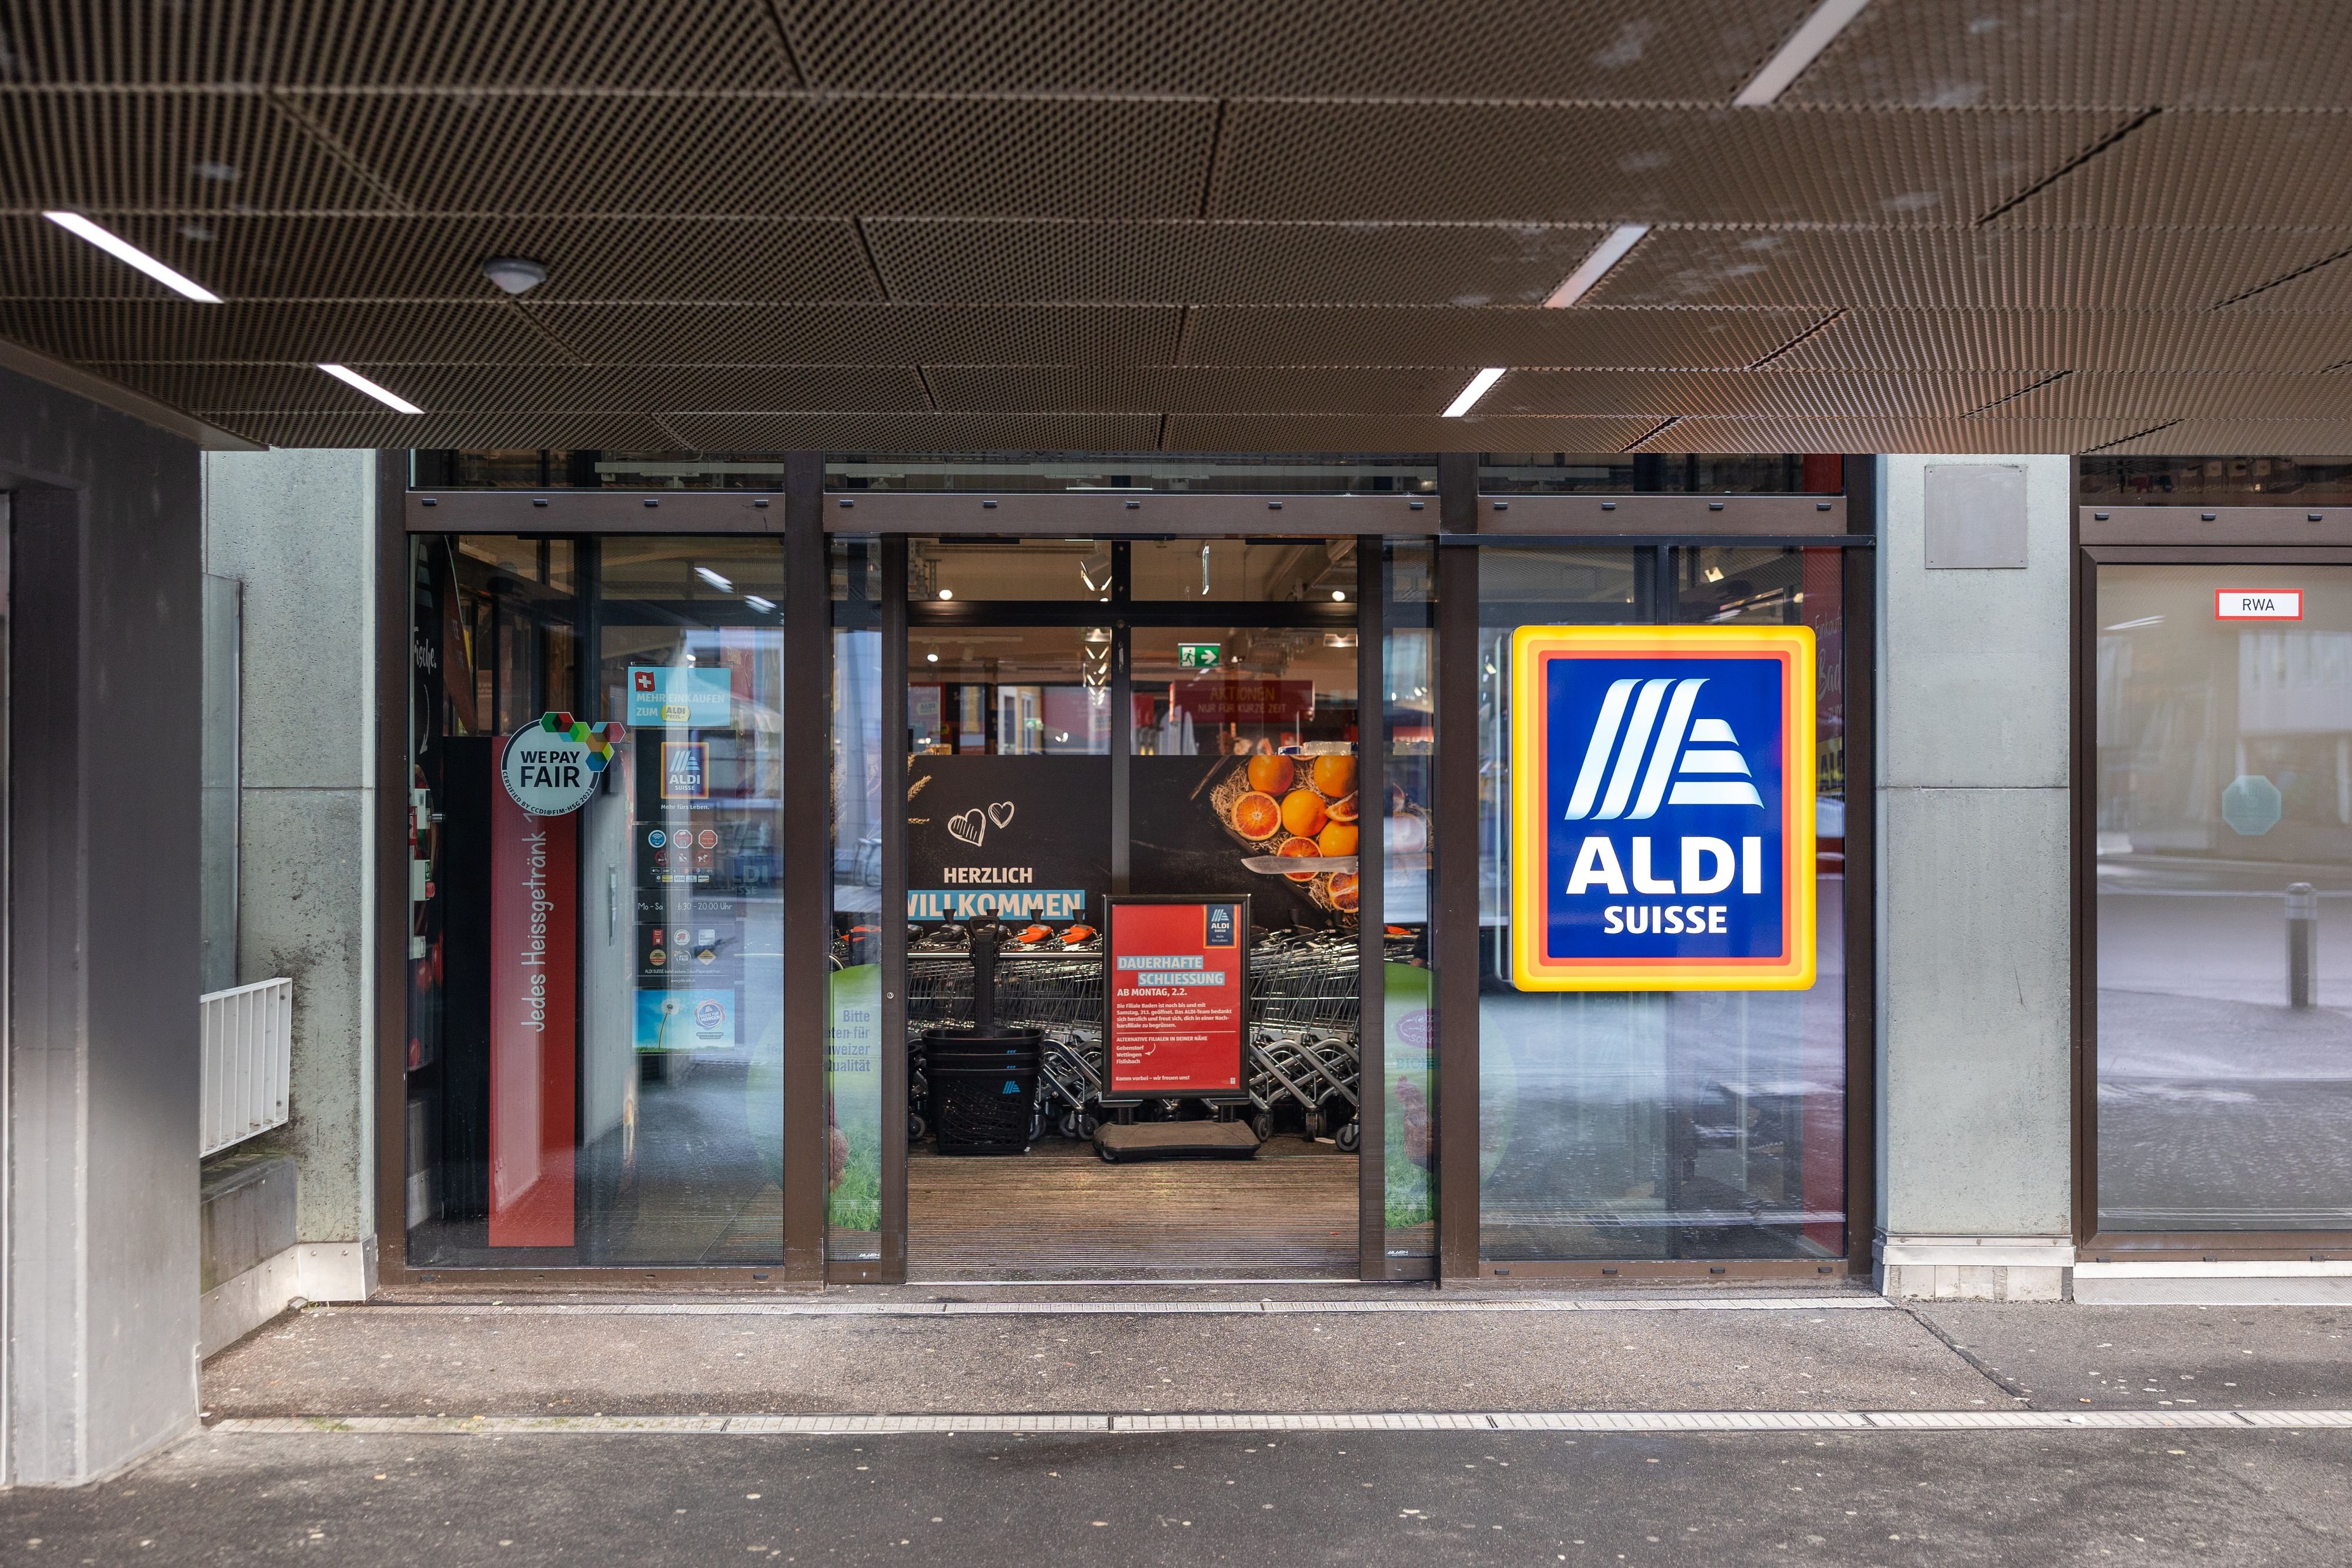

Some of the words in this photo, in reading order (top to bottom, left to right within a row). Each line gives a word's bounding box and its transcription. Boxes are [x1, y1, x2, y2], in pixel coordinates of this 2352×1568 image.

[2243, 599, 2274, 611] RWA
[636, 693, 666, 702] MEHR
[667, 694, 724, 703] EINKAUFEN
[1210, 687, 1275, 701] AKTIONEN
[636, 707, 658, 717] ZUM
[1198, 703, 1215, 713] NUR
[1238, 703, 1264, 713] KURZE
[1268, 703, 1287, 713] ZEIT
[520, 751, 547, 763] WE
[550, 751, 580, 763] PAY
[520, 766, 580, 787] FAIR
[669, 774, 701, 784] ALDI
[502, 771, 522, 803] CERTIFIED
[521, 801, 530, 809] BY
[530, 801, 581, 815] CCDI@FIM-HSG
[580, 788, 593, 803] 2022
[1565, 836, 1762, 894] ALDI
[944, 867, 1033, 883] HERZLICH
[521, 831, 554, 965] Heissgetränk
[1603, 905, 1727, 934] SUISSE
[1118, 957, 1202, 968] DAUERHAFTE
[1139, 973, 1223, 984] SCHLIESSUNG
[1131, 988, 1170, 997] MONTAG,
[521, 974, 545, 1032] Jedes
[843, 1010, 870, 1022] Bitte
[853, 1027, 870, 1039] für
